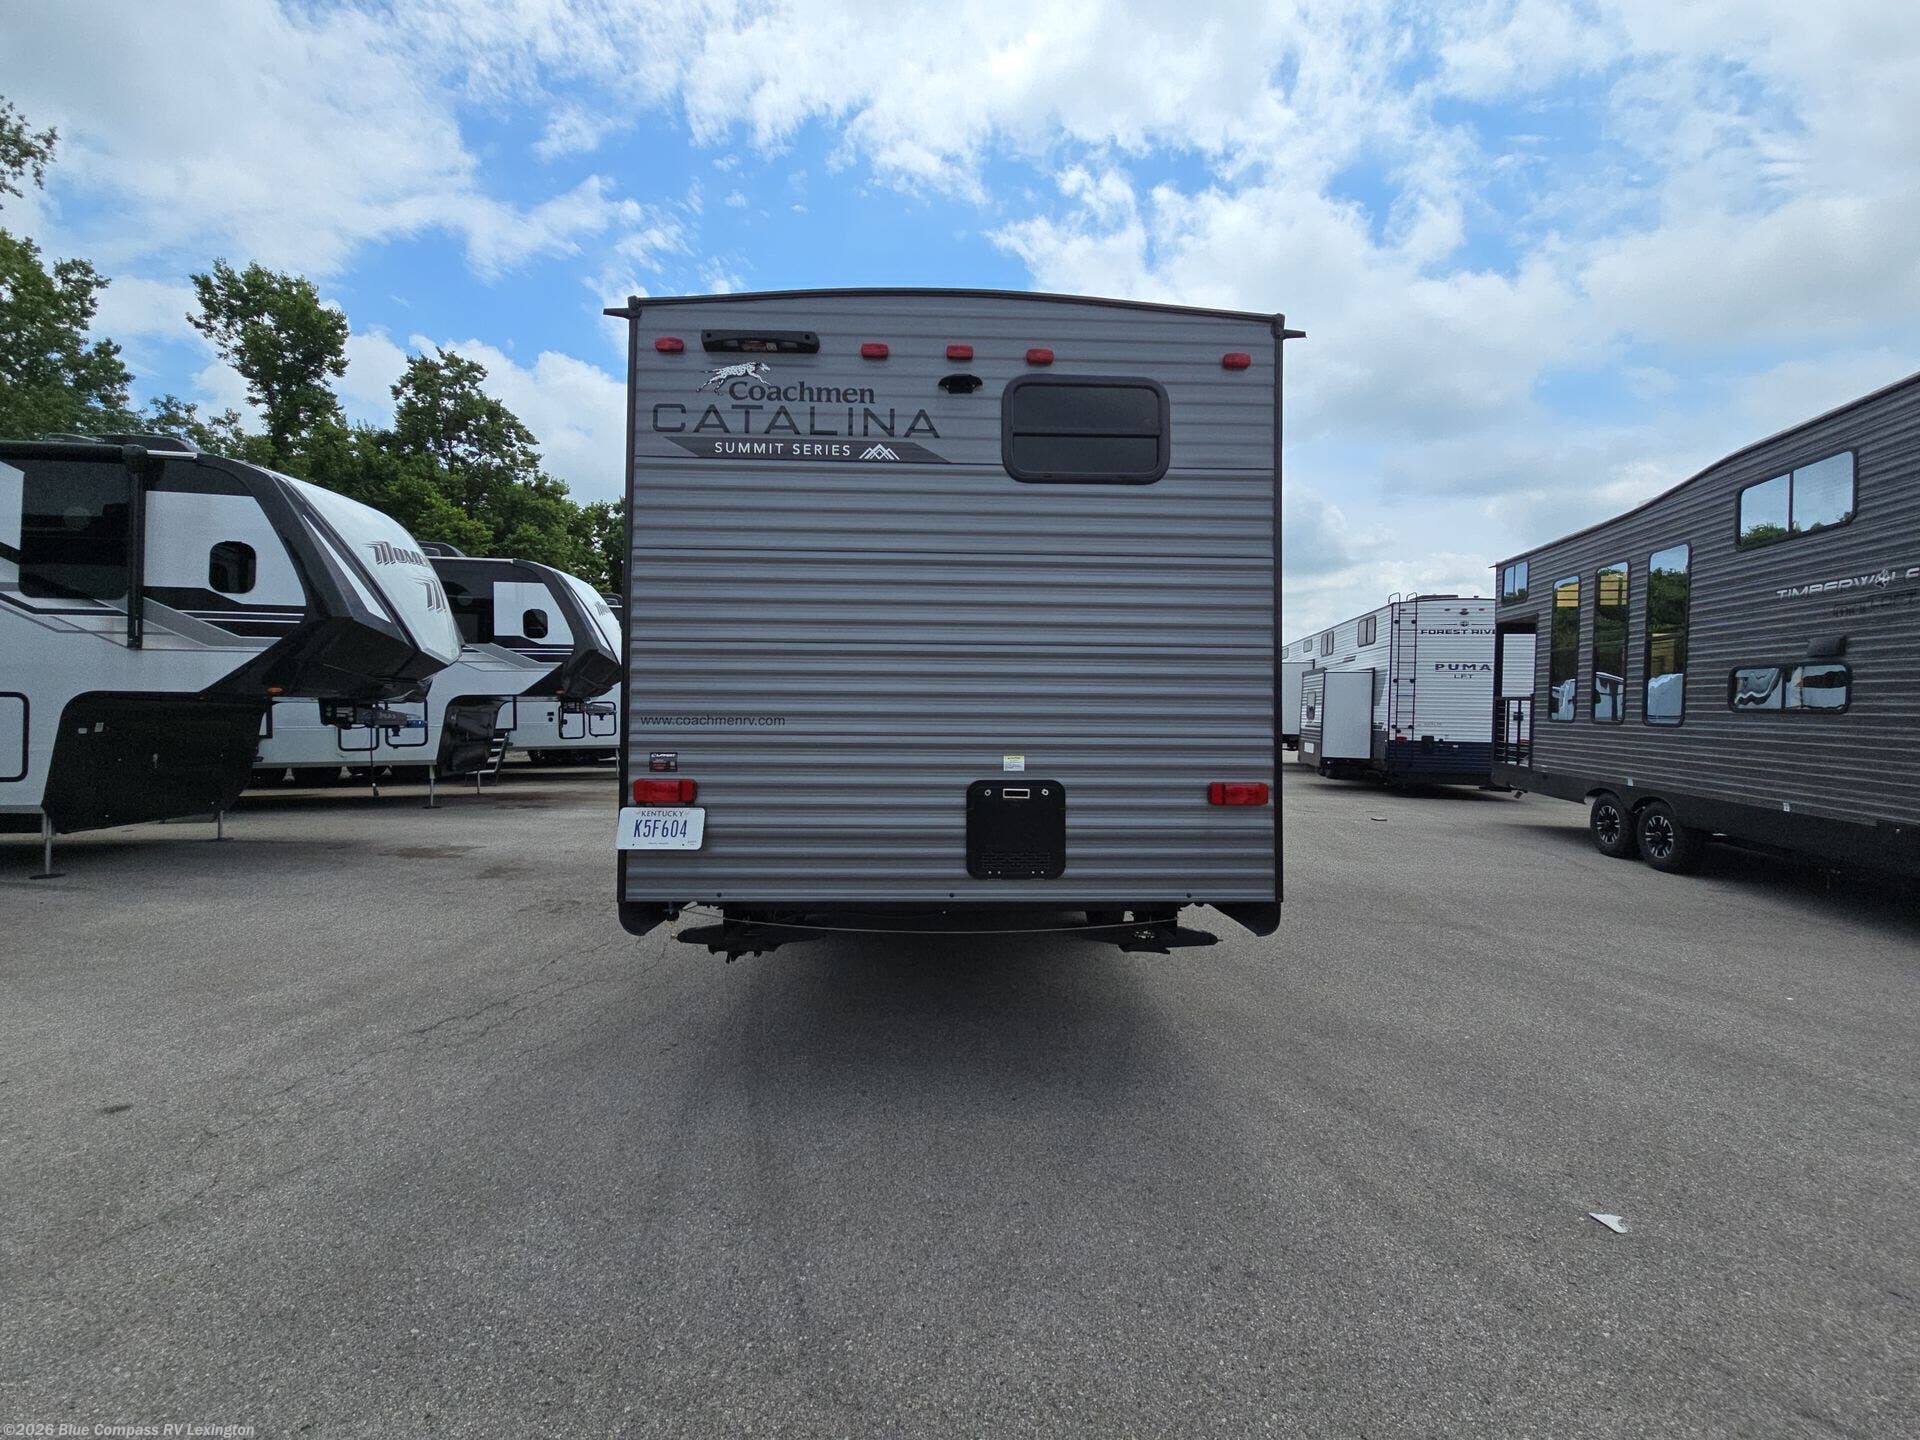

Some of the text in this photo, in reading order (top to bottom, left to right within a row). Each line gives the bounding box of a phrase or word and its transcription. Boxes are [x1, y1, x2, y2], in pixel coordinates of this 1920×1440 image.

[728, 380, 875, 404] Coachmen
[652, 402, 940, 438] CATALINA
[714, 441, 851, 457] SUMMIT SERIES
[1435, 663, 1491, 671] PUMA
[640, 715, 786, 727] www.coachmenrv.com
[641, 810, 684, 818] KENTUCKY
[633, 819, 688, 838] K5F604
